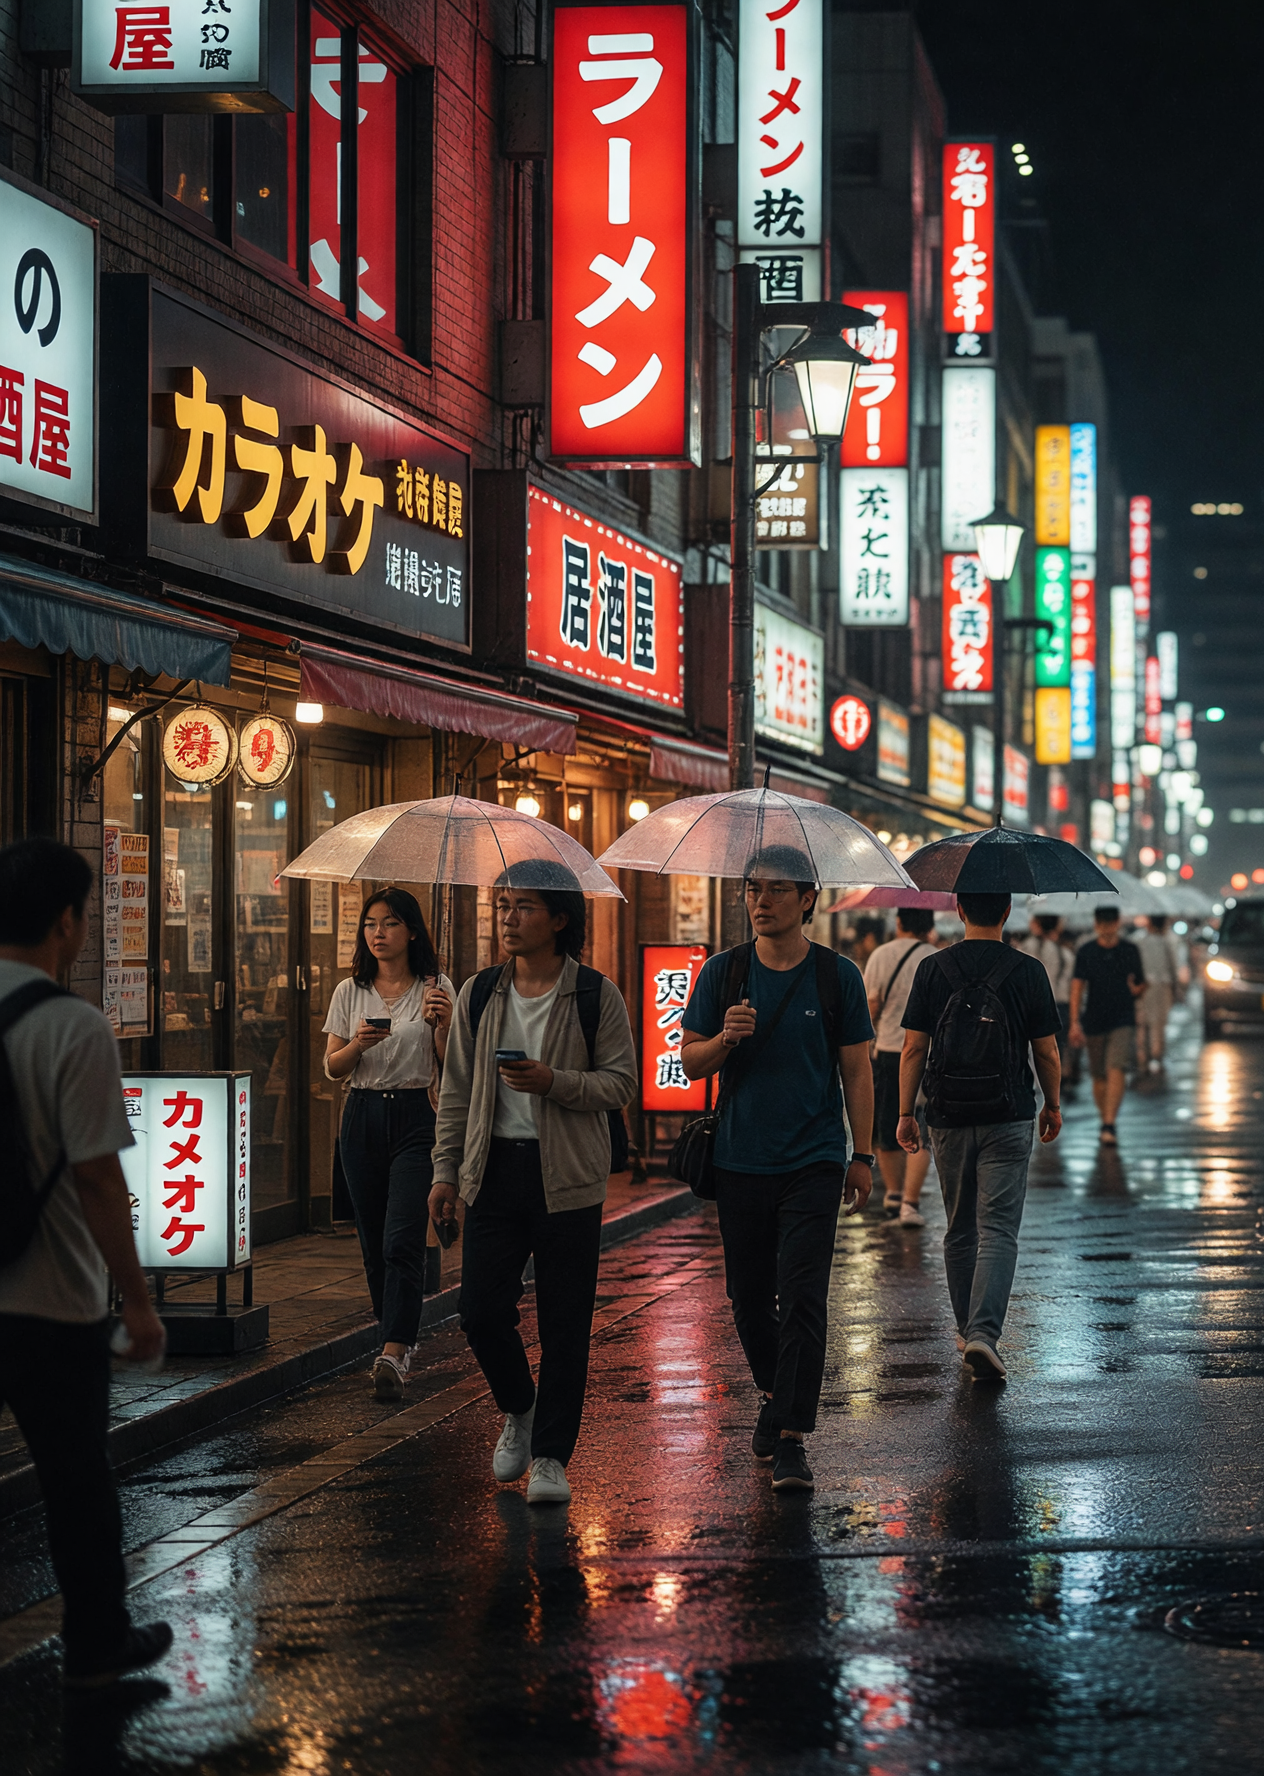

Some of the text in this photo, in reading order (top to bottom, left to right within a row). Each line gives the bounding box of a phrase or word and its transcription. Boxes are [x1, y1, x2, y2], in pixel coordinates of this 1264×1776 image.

[109, 6, 175, 71] 屋
[14, 247, 62, 348] の
[575, 33, 664, 429] ラーメン
[172, 365, 385, 576] カラオケ
[560, 534, 657, 676] 居酒屋
[160, 1090, 206, 1257] カメオケ
